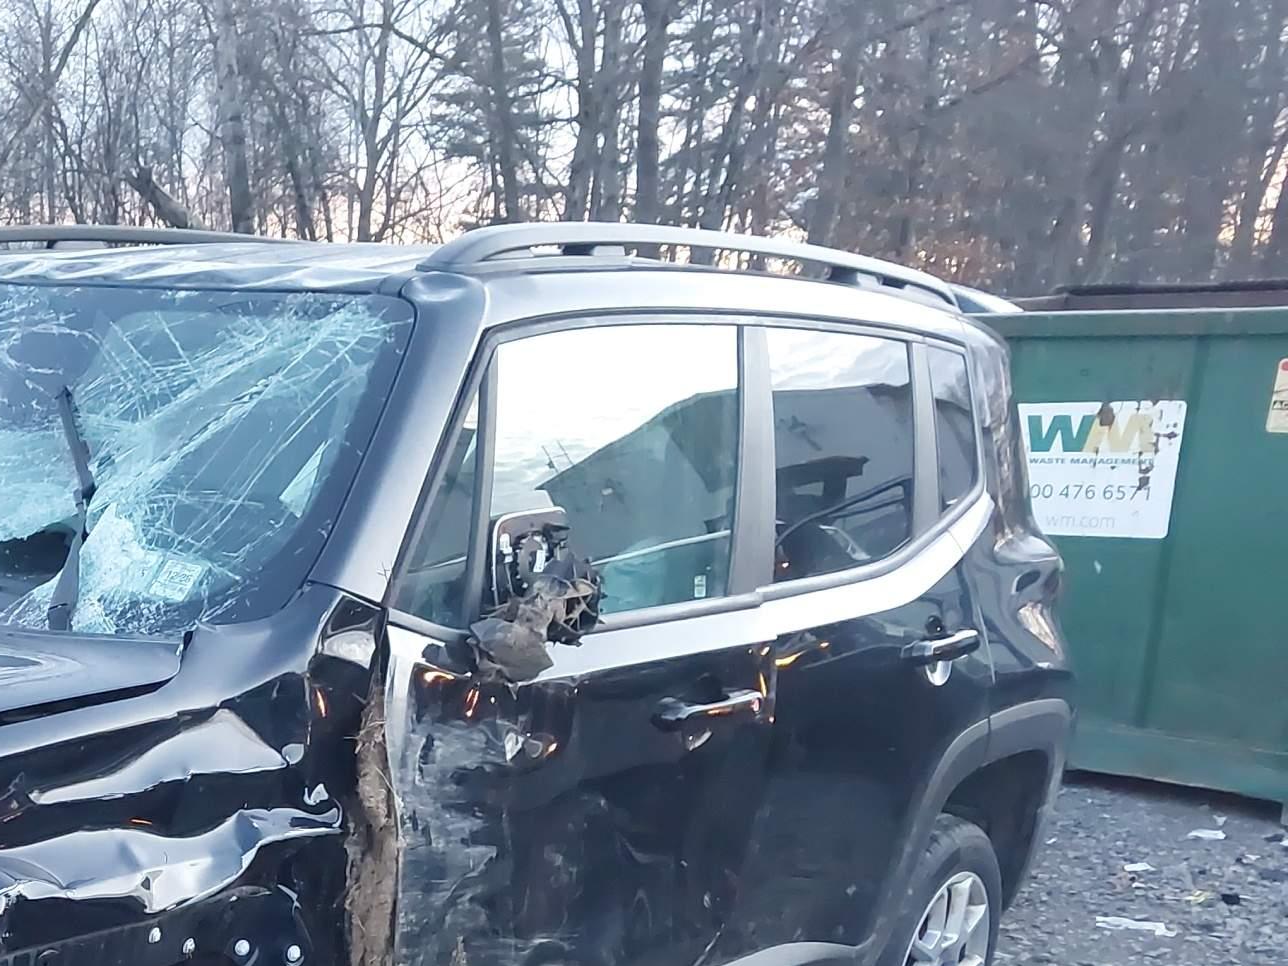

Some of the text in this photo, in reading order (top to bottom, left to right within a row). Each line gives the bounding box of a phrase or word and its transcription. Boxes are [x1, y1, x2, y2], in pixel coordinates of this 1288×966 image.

[1027, 414, 1155, 453] WM
[1029, 457, 1066, 465] WASTE
[1058, 484, 1096, 500] 476
[1103, 484, 1151, 501] 6571
[1046, 515, 1116, 529] wm.com
